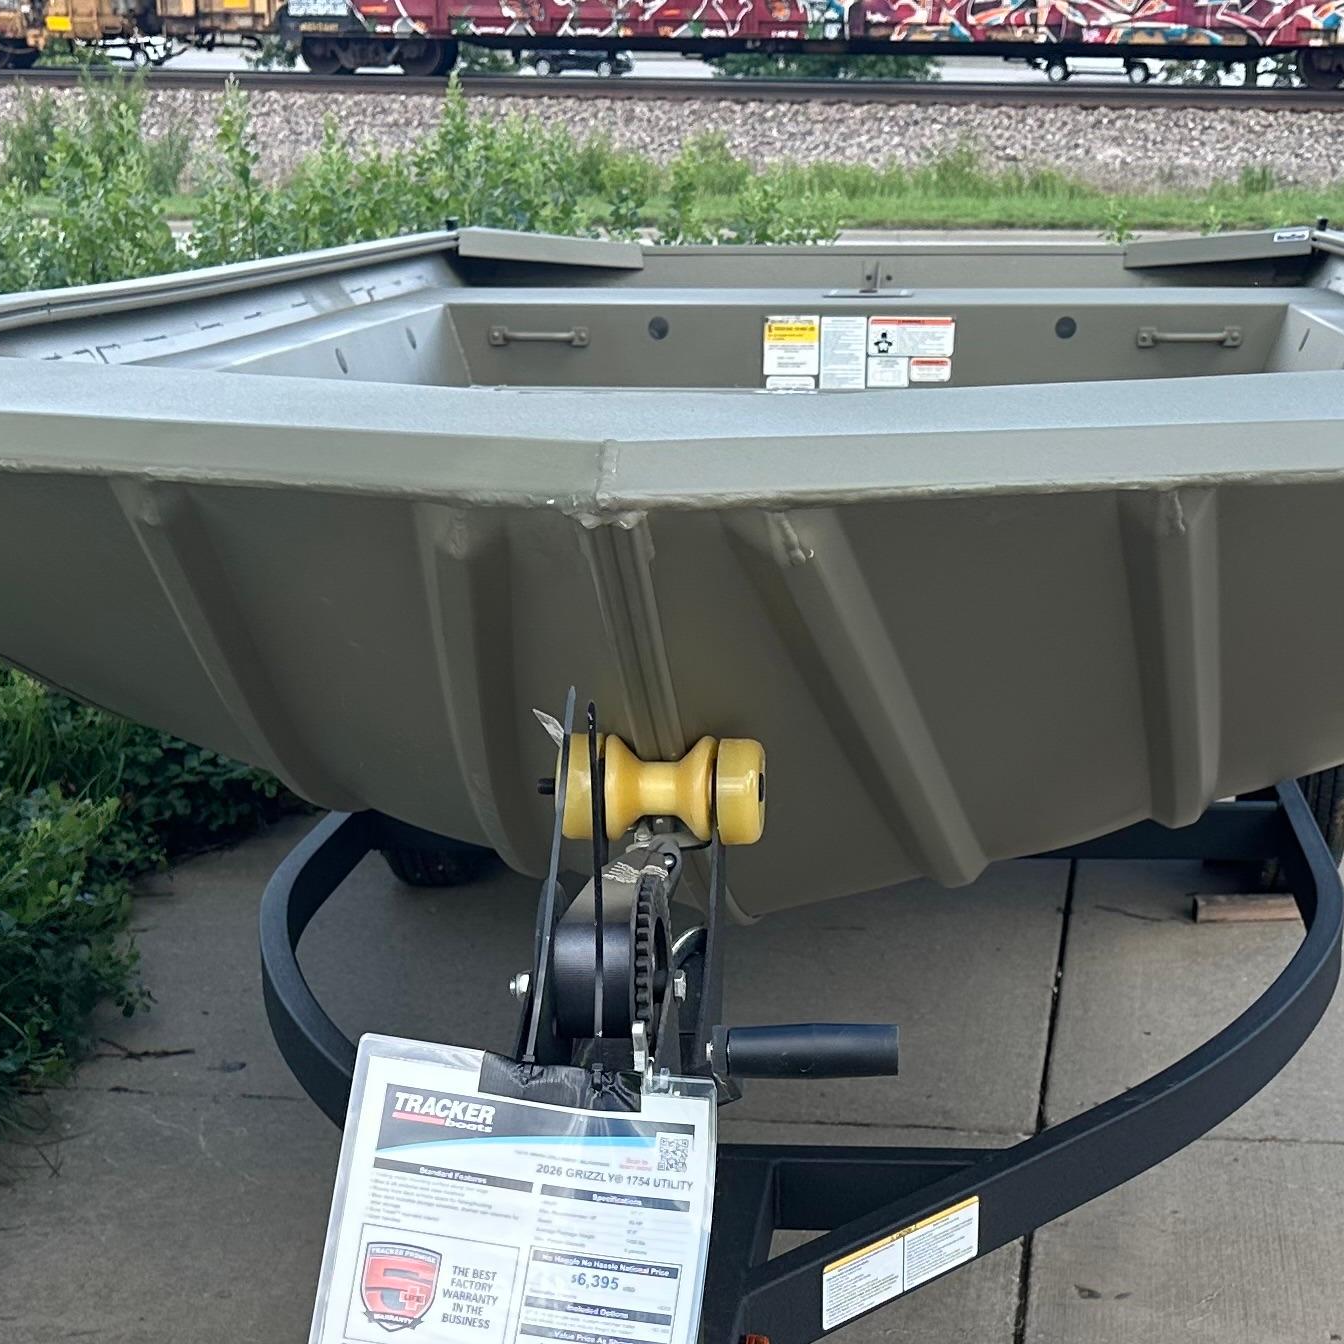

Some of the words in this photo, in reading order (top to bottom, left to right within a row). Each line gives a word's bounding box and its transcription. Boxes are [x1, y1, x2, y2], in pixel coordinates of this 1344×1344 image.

[394, 1091, 496, 1125] TRACKER
[444, 1118, 493, 1133] boats
[419, 1166, 454, 1179] Standard
[454, 1172, 488, 1184] Features
[535, 1163, 563, 1177] 2026
[626, 1175, 650, 1187] 1754
[653, 1178, 694, 1191] UTILITY
[592, 1193, 642, 1206] Specifications
[452, 1265, 470, 1278] THE
[472, 1268, 497, 1281] BEST
[581, 1258, 593, 1267] No
[593, 1260, 618, 1271] Hassle
[619, 1264, 650, 1275] National
[650, 1268, 670, 1277] Price
[450, 1277, 493, 1291] FACTORY
[570, 1272, 620, 1290] $6,395
[442, 1288, 498, 1306] WARRANTY
[452, 1302, 464, 1313] IN
[466, 1304, 484, 1316] THE
[599, 1308, 629, 1320] Options
[441, 1313, 491, 1329] BUSINESS
[553, 1330, 575, 1340] Value
[576, 1333, 596, 1344] Price
[596, 1336, 607, 1344] As
